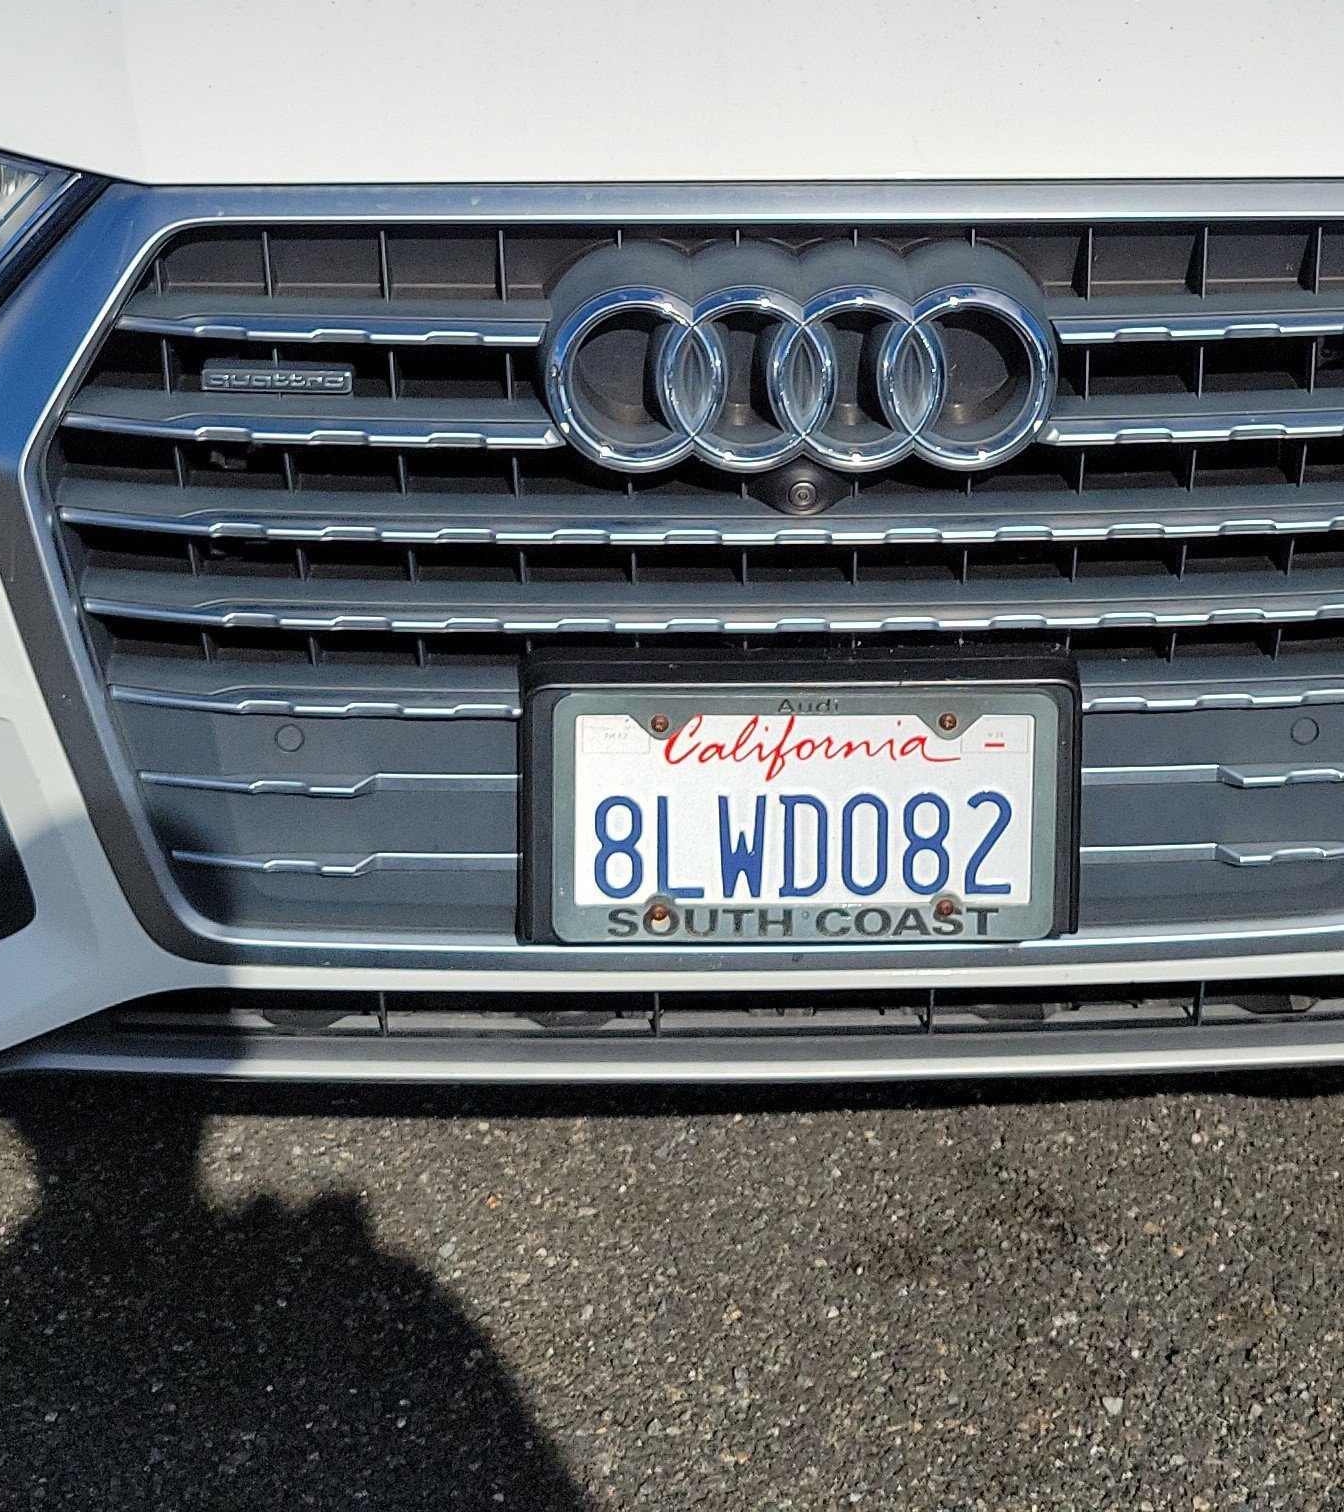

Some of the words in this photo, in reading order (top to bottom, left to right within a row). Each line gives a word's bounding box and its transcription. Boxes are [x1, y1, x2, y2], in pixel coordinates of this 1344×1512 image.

[209, 372, 345, 388] quattro
[777, 698, 839, 712] Audi
[663, 714, 960, 781] California
[593, 791, 1013, 899] 8LWD082
[607, 906, 792, 938] SOUTH
[816, 906, 999, 938] COAST
